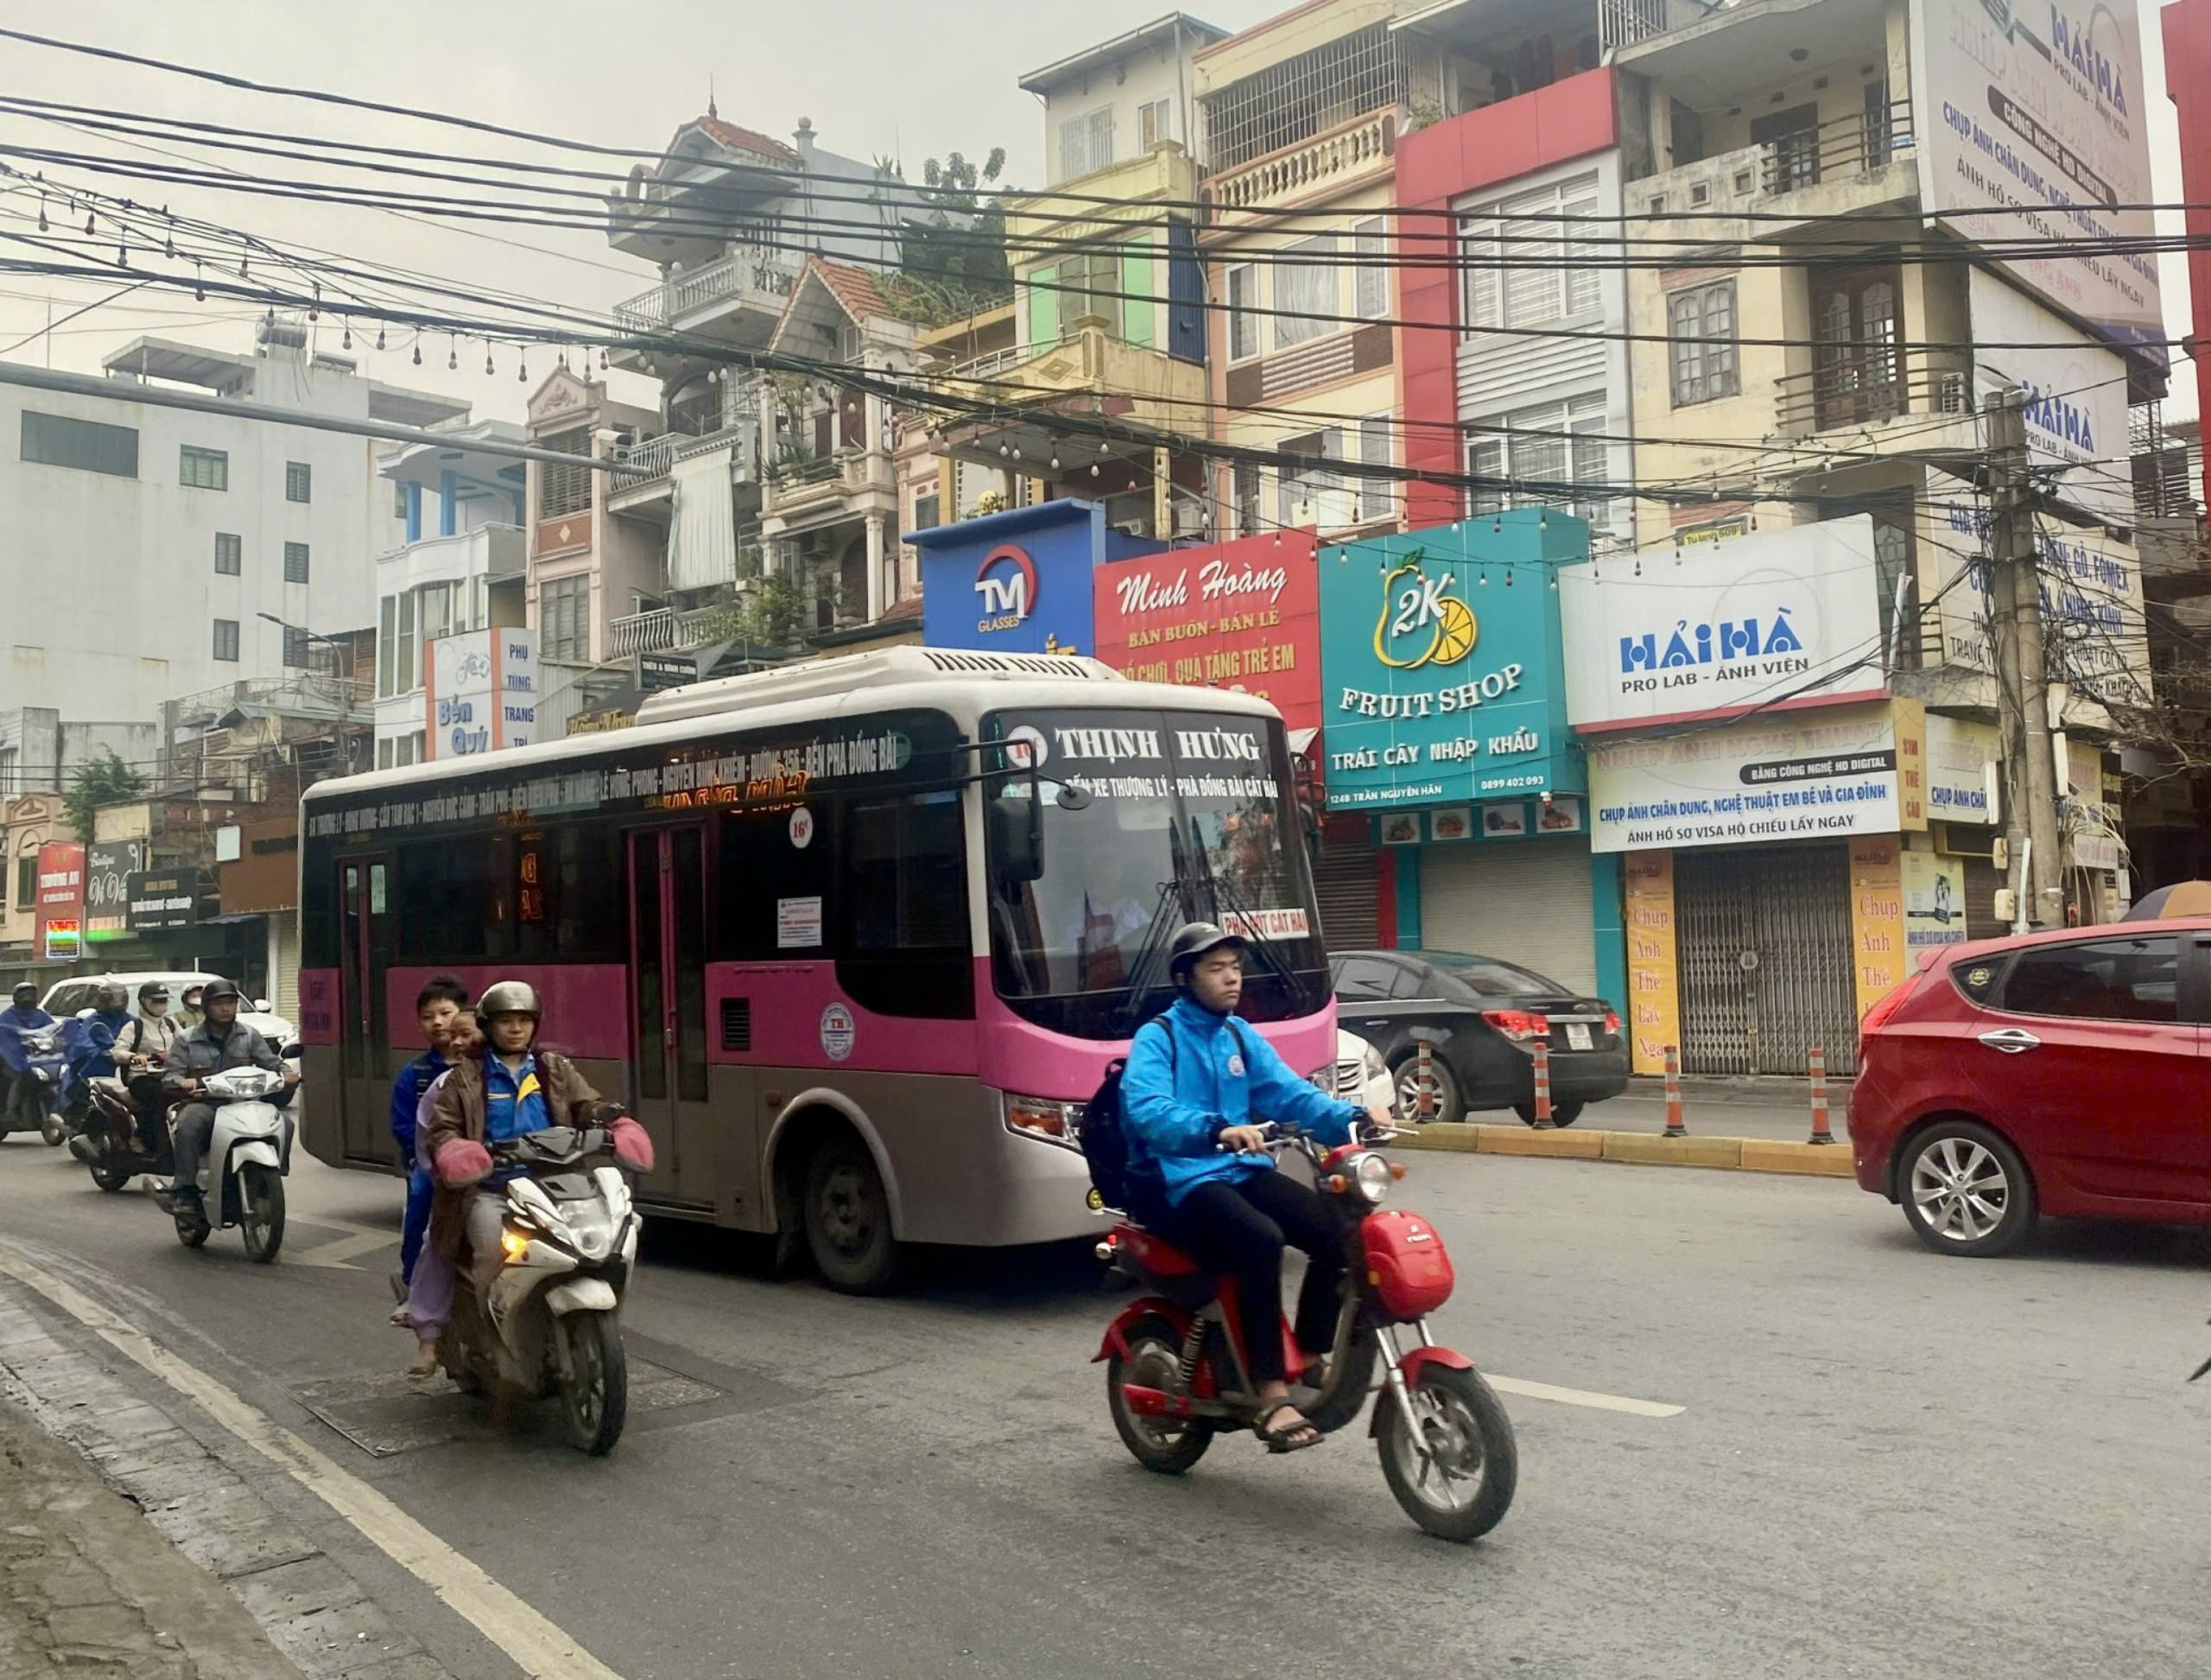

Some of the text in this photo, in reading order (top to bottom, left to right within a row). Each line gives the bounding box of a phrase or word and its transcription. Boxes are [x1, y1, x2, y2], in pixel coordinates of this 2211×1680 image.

[2054, 58, 2071, 85] PRO
[2073, 77, 2088, 102] LAB
[1943, 101, 1971, 141] CHỤP
[2043, 437, 2057, 454] LAB
[1117, 560, 1288, 616] Minh Hoàng
[1391, 573, 1453, 638] 2K
[978, 614, 1020, 633] GLASSES
[1129, 625, 1161, 649] BÁN
[1165, 620, 1209, 642] BUÔN
[1219, 611, 1254, 633] BÁN
[510, 643, 528, 662] PHỤ
[1175, 652, 1202, 683] QUÀ
[1272, 643, 1296, 671] EM
[1340, 663, 1524, 719] FRUIT SHOP
[1621, 678, 1657, 694] PRO
[1663, 673, 1697, 689] LAB
[1762, 657, 1809, 675] VIỆN
[504, 706, 535, 722] TRANG
[451, 726, 489, 754] Quý
[827, 734, 846, 777] PHÀ
[878, 729, 897, 770] BÀI
[1055, 726, 1260, 764] THỊNH HƯNG
[1332, 745, 1378, 772] TRÁI
[1384, 742, 1421, 766] CÂY
[1429, 736, 1479, 762] NHẬP
[1481, 775, 1544, 790] 0899 402 093
[1779, 762, 1805, 777] CÔNG
[1835, 761, 1848, 771] HD
[1851, 757, 1886, 769] DIGITAL
[1093, 778, 1109, 797] XE
[1109, 776, 1153, 800] THƯỢNG
[1156, 774, 1169, 797] LÝ
[1176, 774, 1199, 797] PHÀ
[1227, 774, 1245, 798] BÀI
[1329, 791, 1351, 803] 124B
[1600, 807, 1625, 825] CHỤP
[1650, 800, 1677, 818] CHÂN
[1680, 800, 1712, 815] DUNG,
[1714, 793, 1742, 815] NGHỆ
[1745, 791, 1780, 811] THUẬT
[1783, 792, 1799, 807] EM
[1802, 786, 1816, 804] BÉ
[1818, 784, 1833, 803] VÀ
[1835, 787, 1854, 802] GIA
[1856, 781, 1886, 800] ĐÌNH
[1931, 786, 1952, 810] CHỤP
[1971, 788, 1986, 808] CHÂ
[1677, 827, 1693, 840] SƠ
[1695, 825, 1724, 838] VISA
[1749, 817, 1786, 834] CHIẾU
[1790, 815, 1815, 831] LẤY
[1818, 815, 1854, 829] NGAY
[1638, 1037, 1665, 1058] Nga
